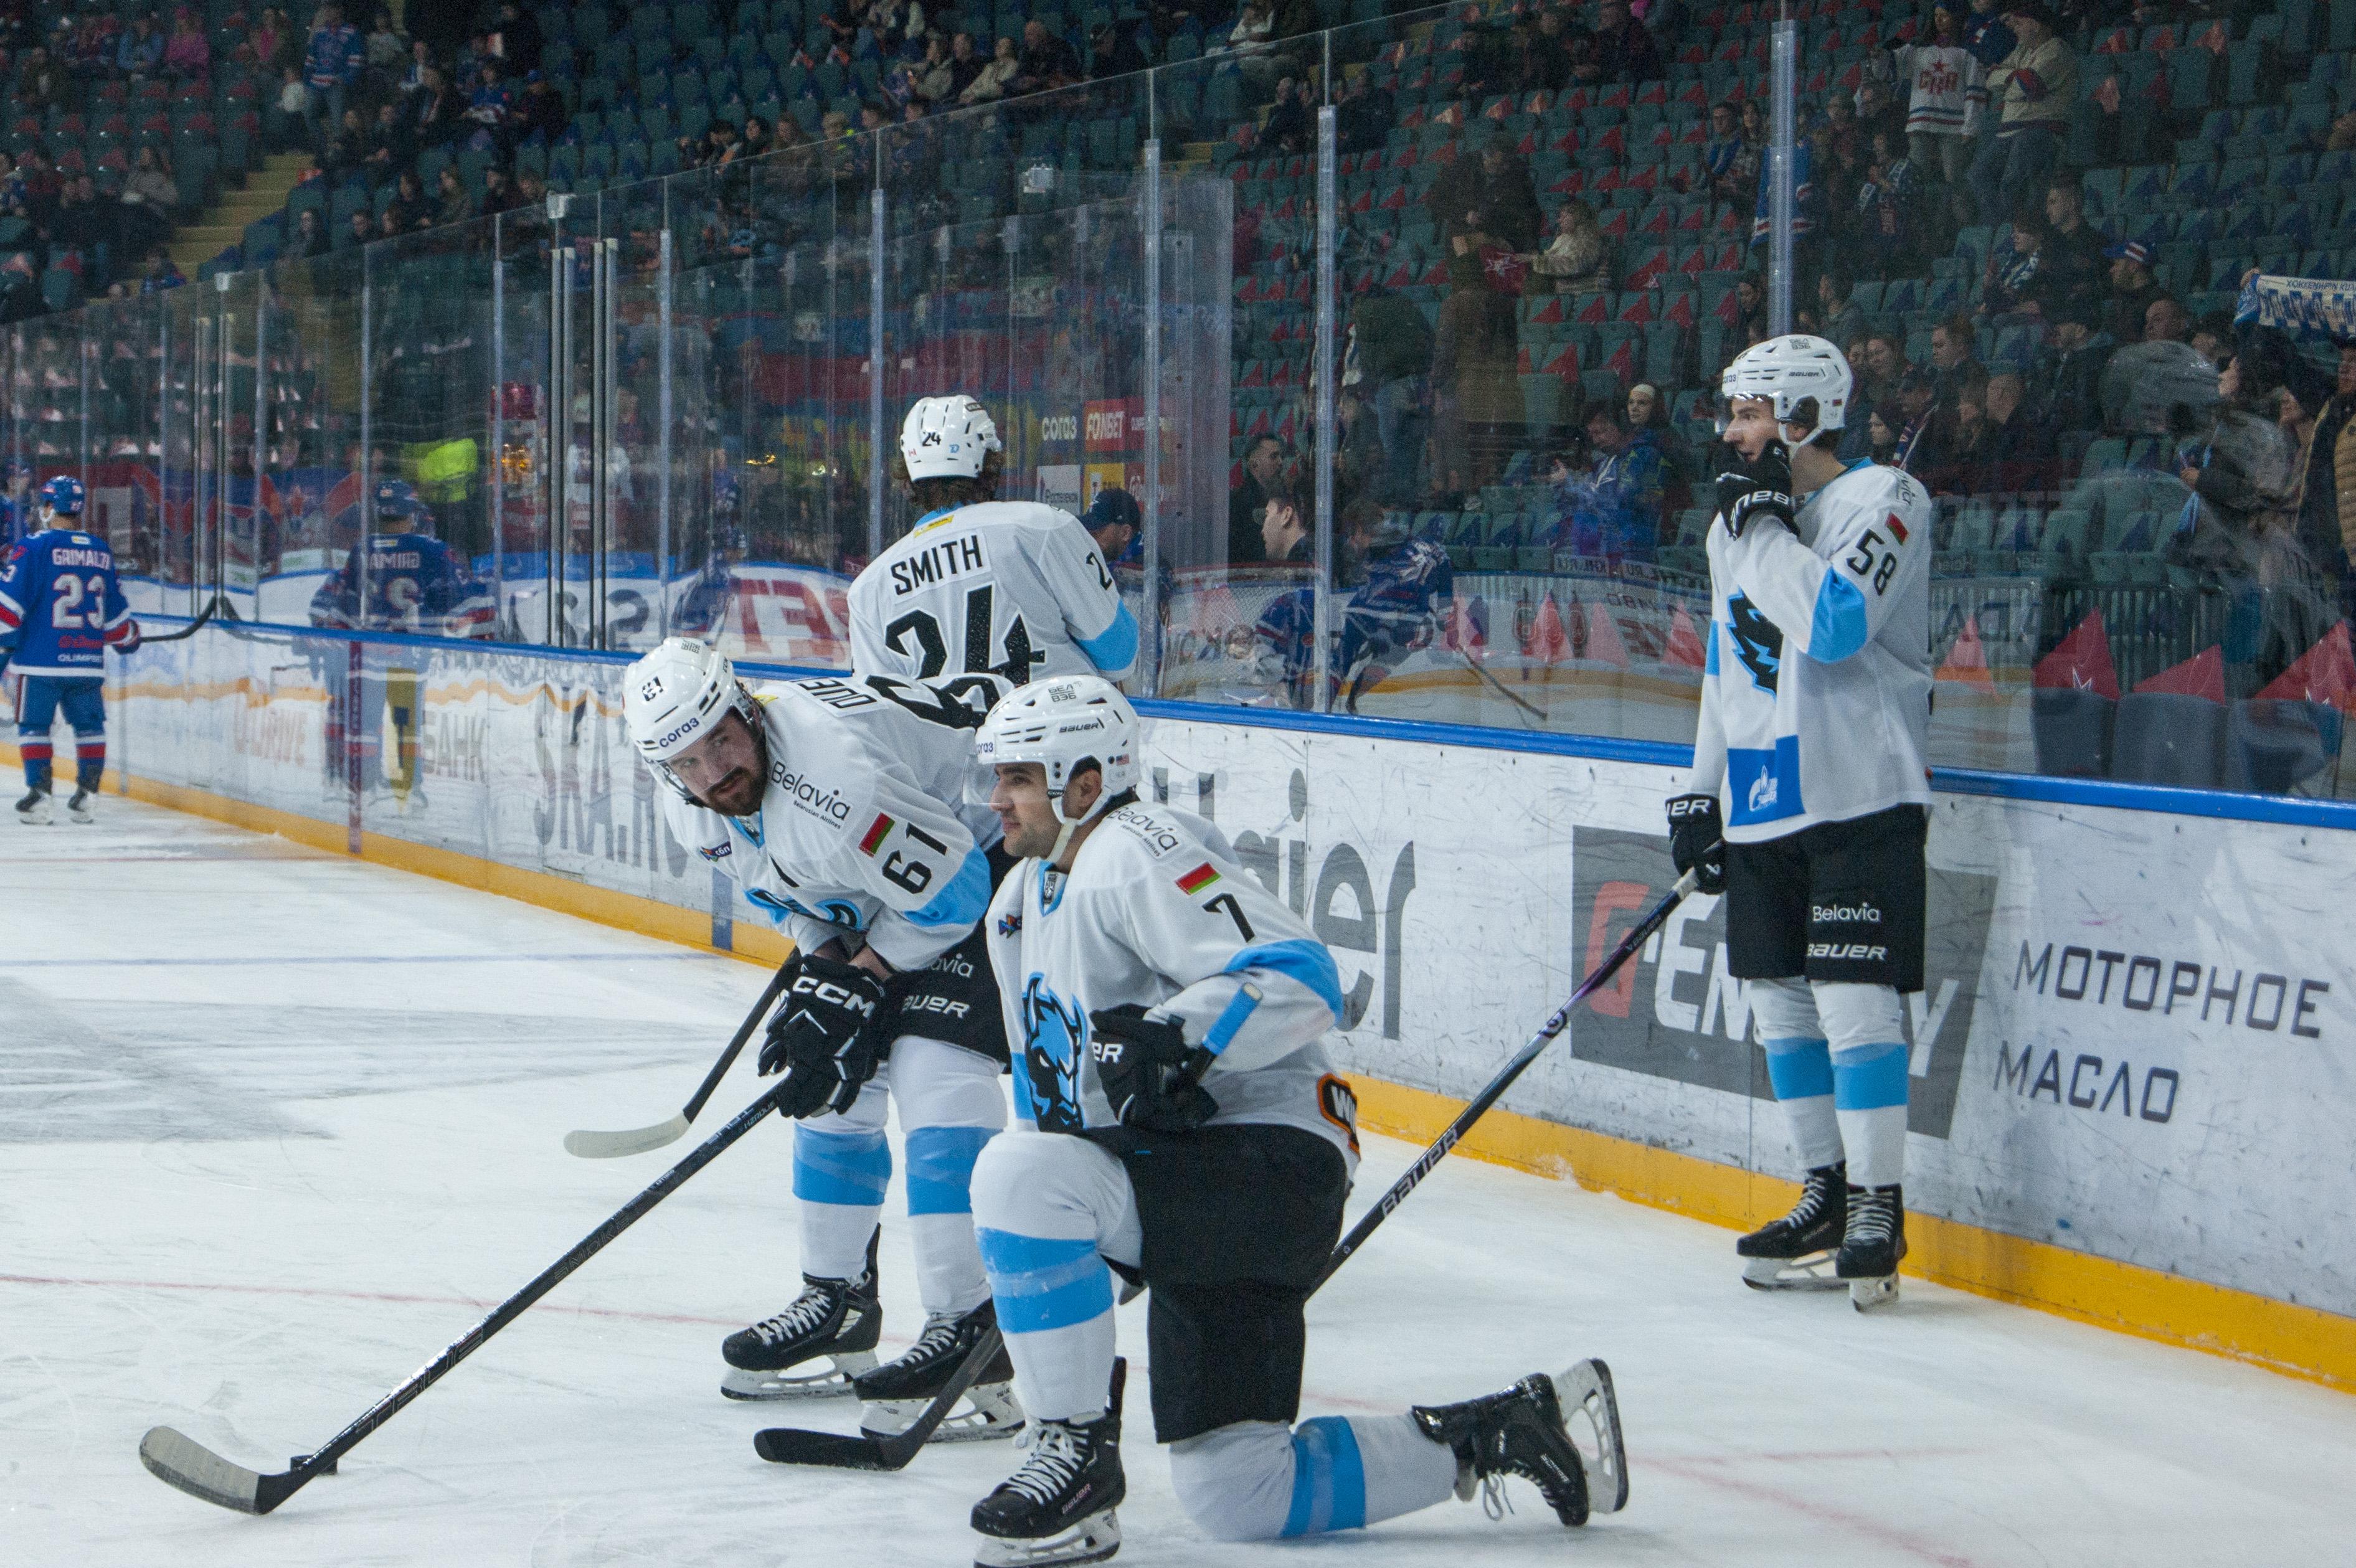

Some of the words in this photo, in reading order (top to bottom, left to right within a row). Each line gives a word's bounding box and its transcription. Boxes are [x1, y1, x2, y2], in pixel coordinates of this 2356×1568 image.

[922, 431, 942, 447] 24
[891, 534, 983, 596] SMITH
[1847, 528, 1897, 596] 58
[52, 572, 105, 630] 23
[1059, 722, 1099, 733] BAUER
[771, 760, 851, 821] Belavia
[793, 800, 820, 820] Belarusian
[820, 814, 841, 829] Airlines
[882, 822, 948, 894] 61
[1203, 892, 1256, 943] 7
[1813, 902, 1880, 923] Belavia
[792, 976, 875, 1020] CCM
[2013, 939, 2330, 1039] МОТОРНОЕ
[1993, 1040, 2179, 1124] МАСЛО
